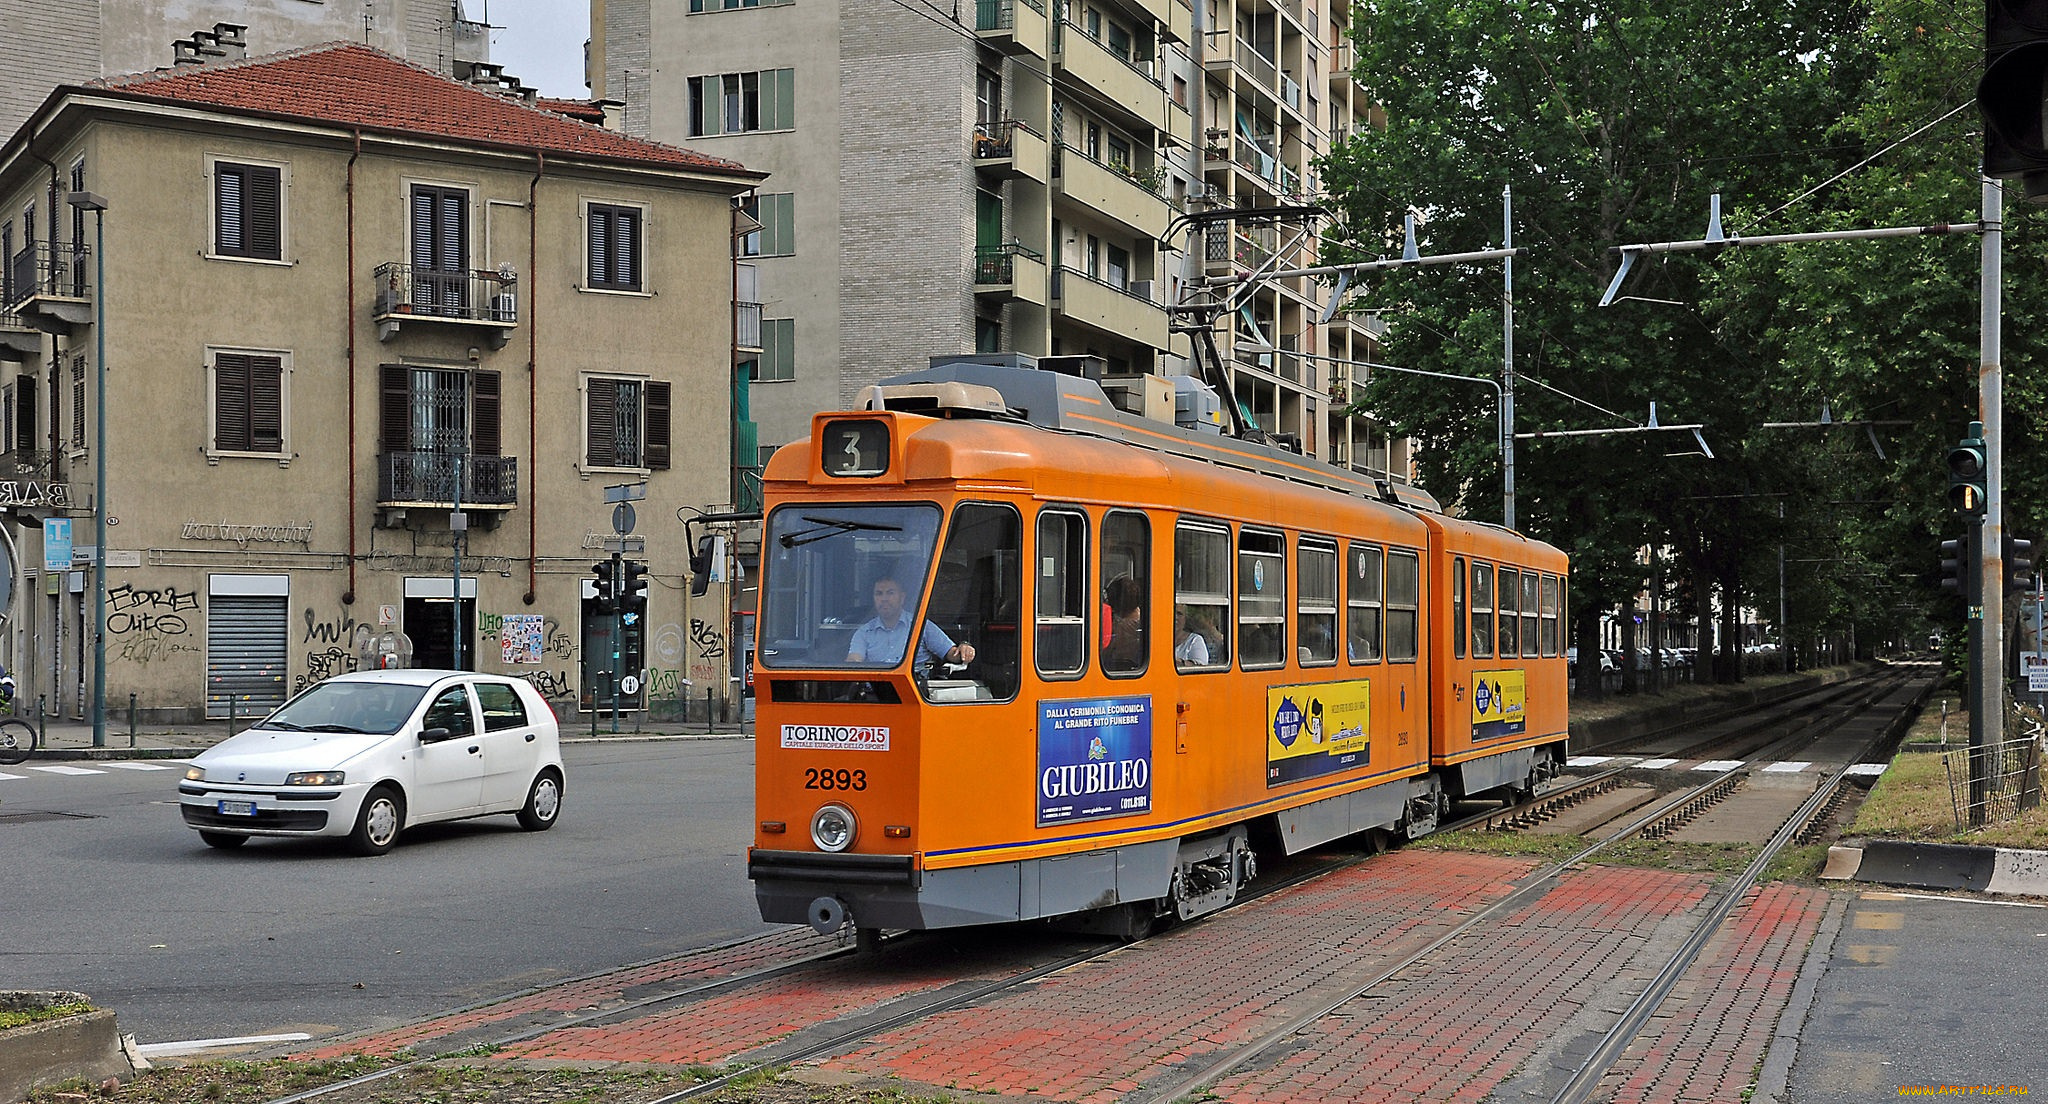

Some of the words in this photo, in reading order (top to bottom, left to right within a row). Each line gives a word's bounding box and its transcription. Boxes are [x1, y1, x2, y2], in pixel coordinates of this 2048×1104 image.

[841, 431, 861, 472] 3
[1046, 709, 1068, 718] DALLA
[1069, 706, 1106, 717] CERIMONIA
[1107, 704, 1145, 714] ECONOMICA
[1054, 720, 1064, 730] AL
[1065, 718, 1093, 729] GRANDE
[1093, 717, 1110, 727] RITO
[1110, 715, 1139, 726] FUNEBRE
[804, 767, 868, 792] 2893
[1042, 758, 1148, 799] GIUBILEO
